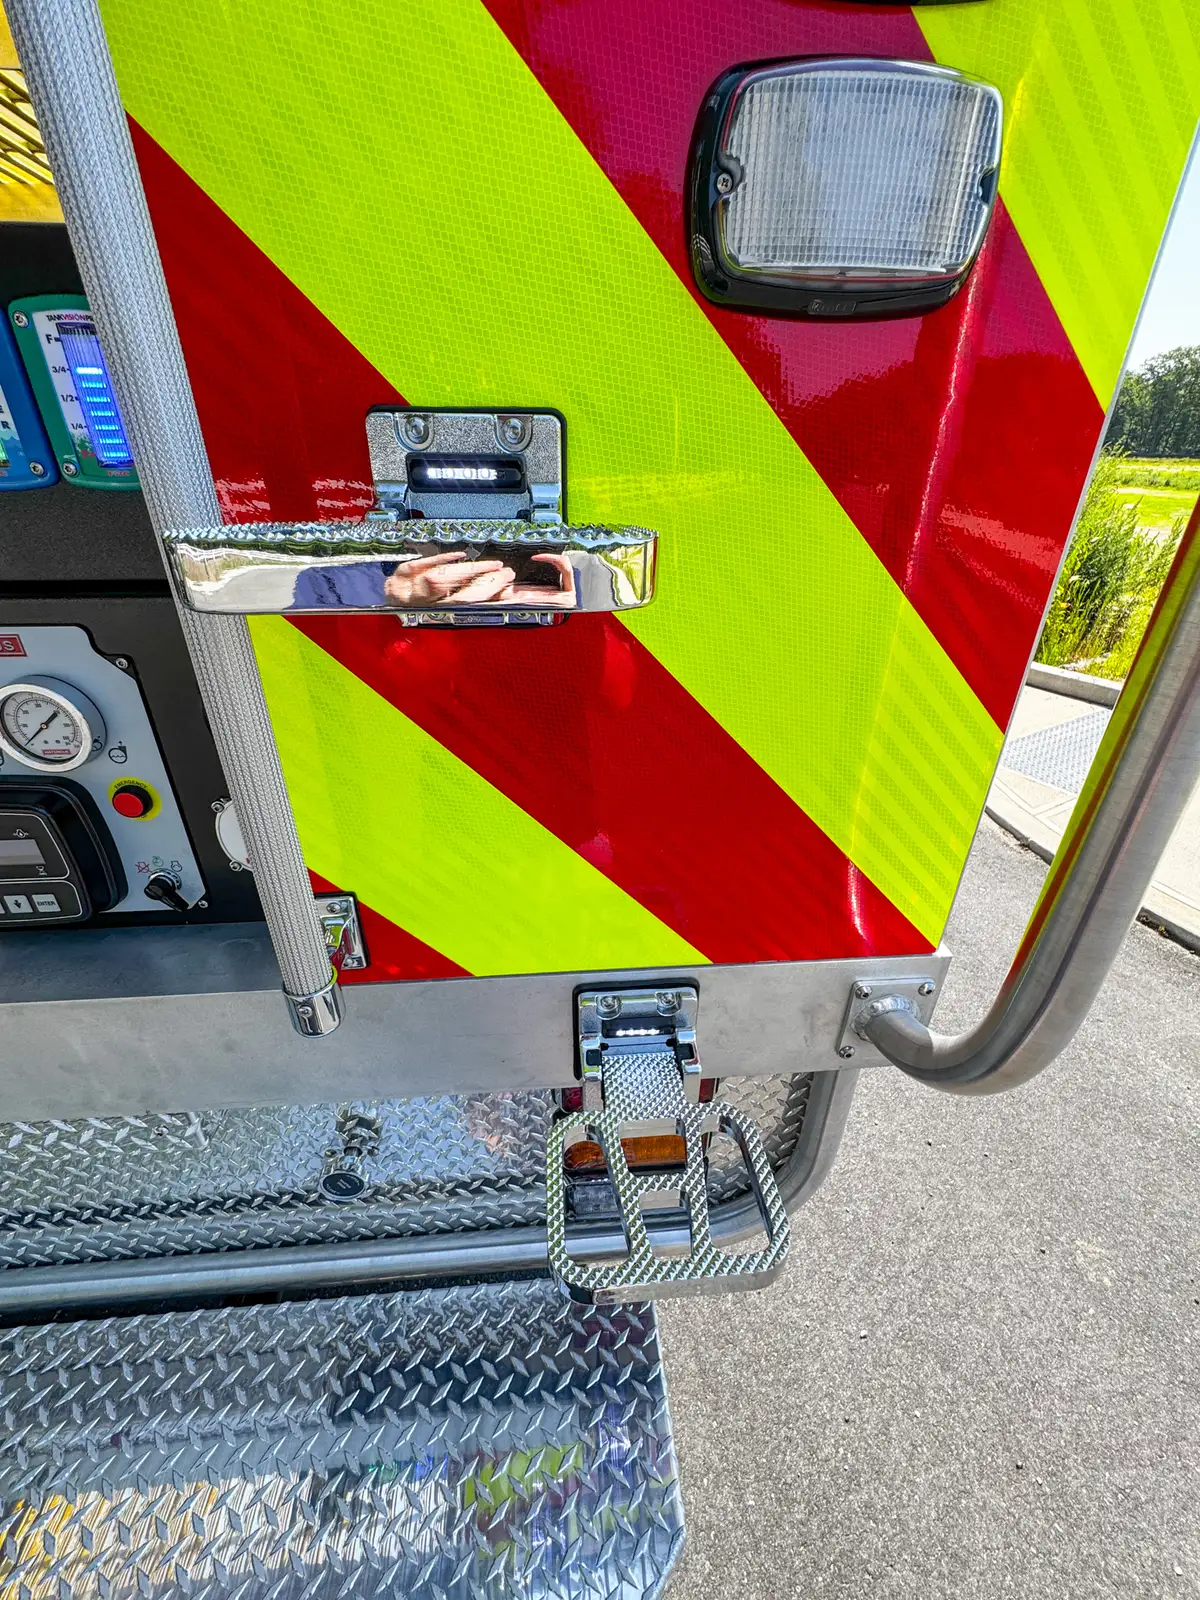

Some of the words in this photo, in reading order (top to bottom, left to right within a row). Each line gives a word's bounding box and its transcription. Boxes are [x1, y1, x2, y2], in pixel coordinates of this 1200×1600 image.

[45, 334, 53, 344] F
[52, 366, 67, 374] 3/4
[61, 394, 75, 402] 1/2
